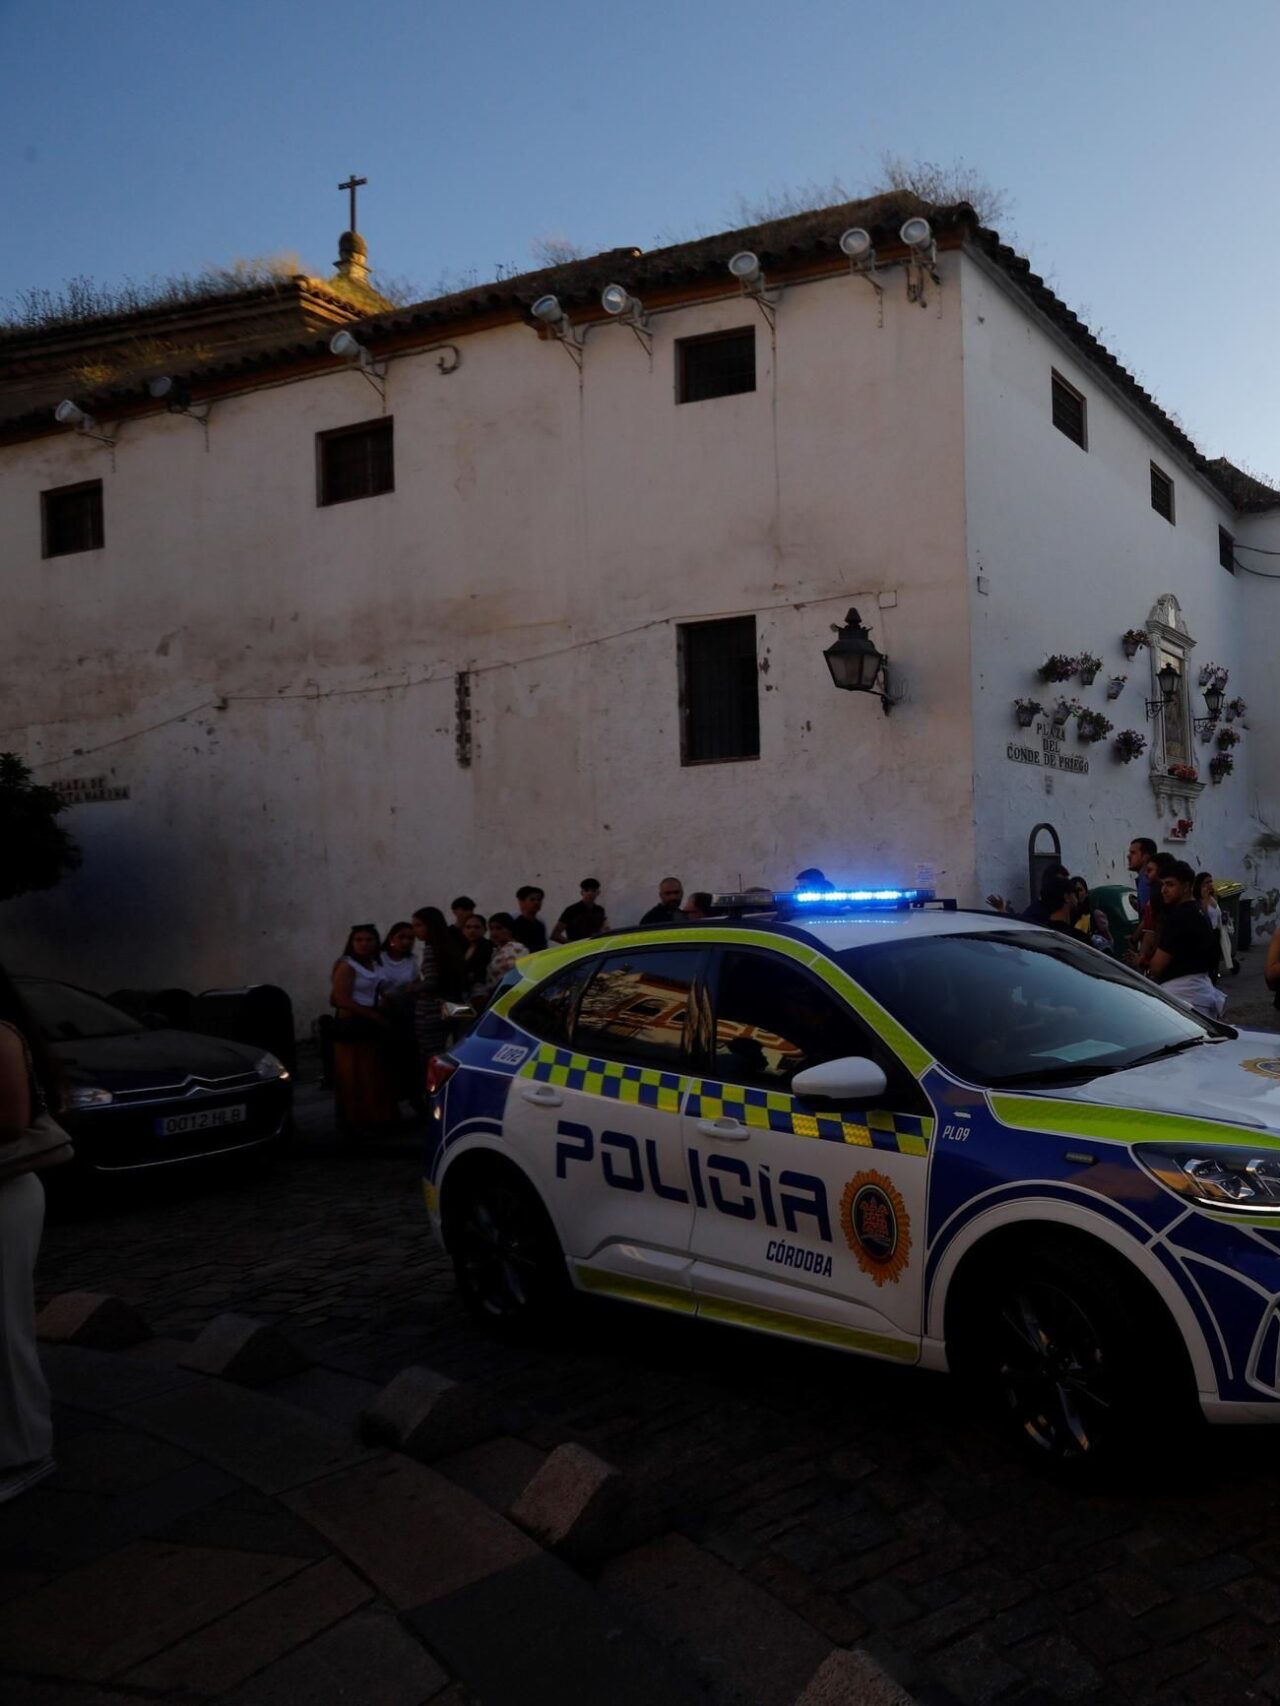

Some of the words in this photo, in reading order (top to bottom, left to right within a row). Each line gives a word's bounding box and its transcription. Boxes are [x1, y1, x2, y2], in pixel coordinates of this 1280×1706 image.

[1036, 722, 1066, 741] PLAZA
[1043, 739, 1060, 753] DEL
[1006, 745, 1040, 763] CONDE
[1044, 753, 1057, 767] DE
[1059, 755, 1089, 773] PRIEGO
[166, 1114, 208, 1132] 0012
[942, 1125, 970, 1141] PL09
[556, 1120, 833, 1243] POLICÍA
[766, 1240, 833, 1278] CÓRDOBA
